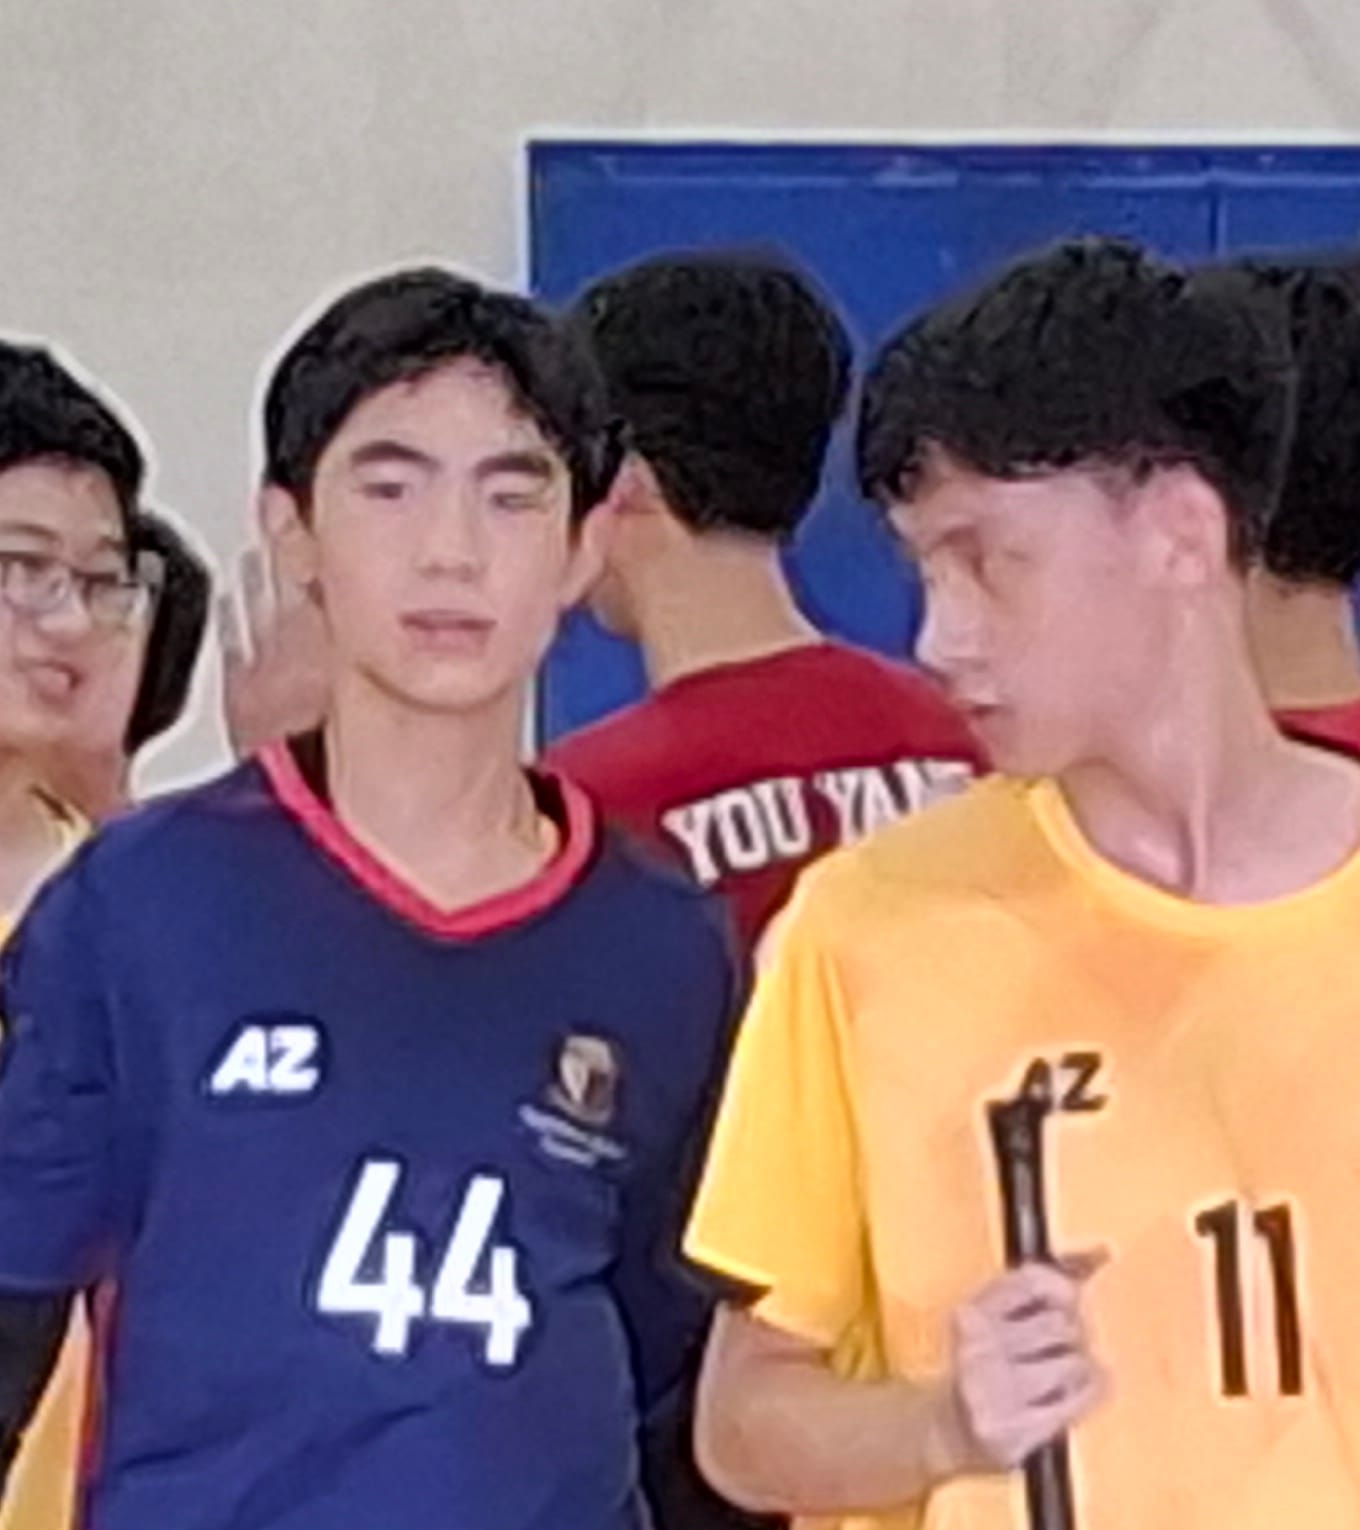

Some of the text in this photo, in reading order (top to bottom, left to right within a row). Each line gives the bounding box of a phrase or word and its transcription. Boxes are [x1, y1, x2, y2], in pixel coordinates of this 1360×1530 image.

[661, 776, 811, 888] YOU
[210, 1025, 320, 1094] AZ
[316, 1160, 534, 1367] 44
[1195, 1200, 1302, 1397] 11
